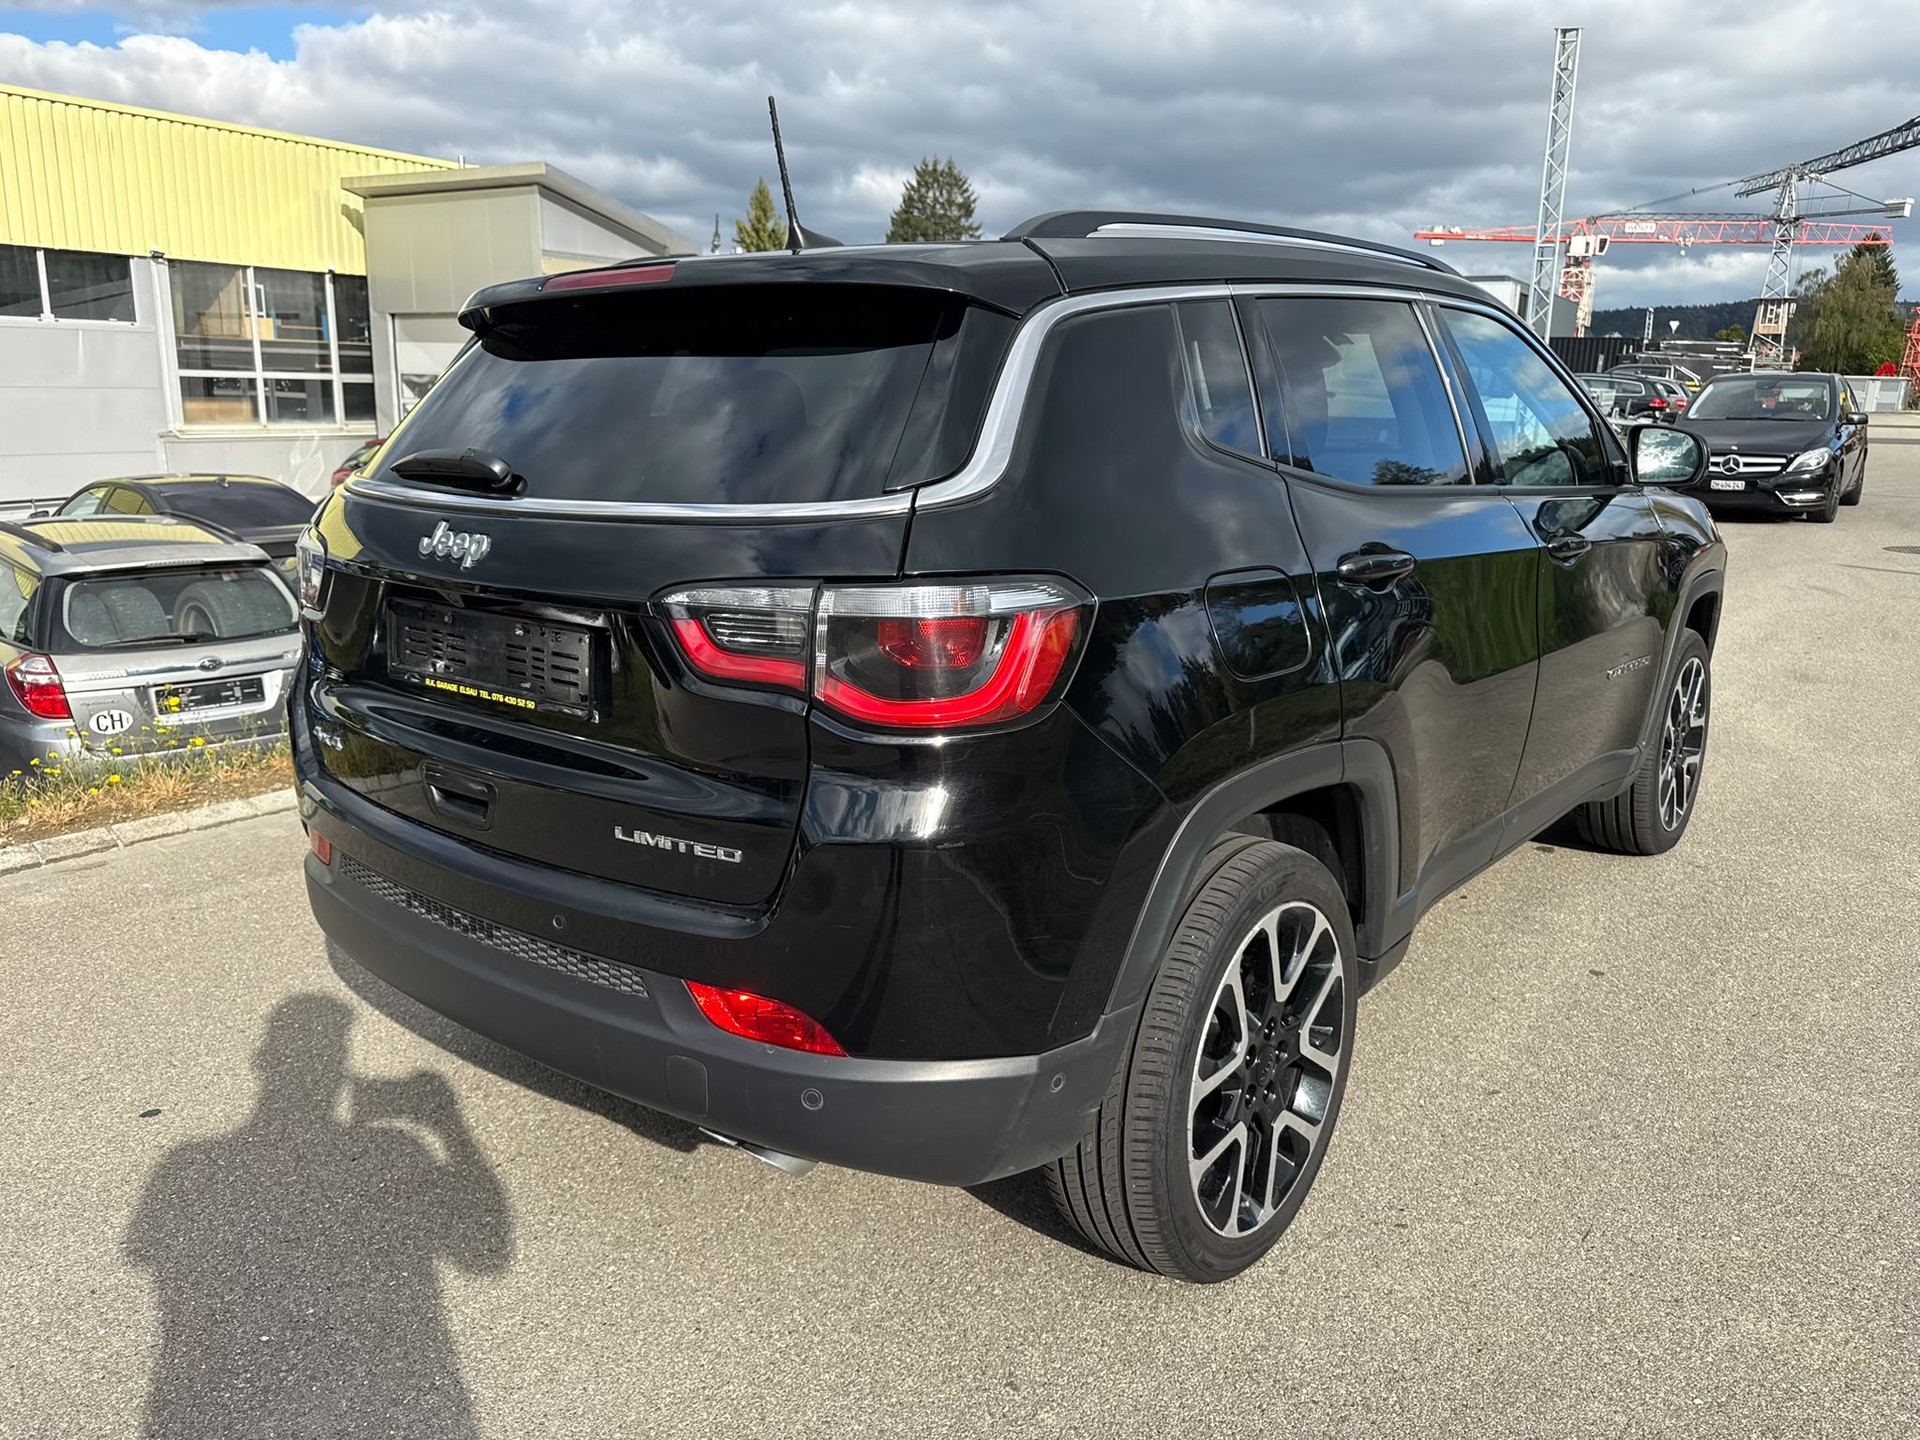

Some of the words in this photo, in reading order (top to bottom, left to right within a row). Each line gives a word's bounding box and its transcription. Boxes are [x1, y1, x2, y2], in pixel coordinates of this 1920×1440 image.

[419, 520, 489, 568] Jeep
[436, 681, 458, 692] GARAGE
[459, 686, 477, 697] ELSAU
[504, 696, 516, 705] 430
[517, 699, 526, 707] 52
[526, 701, 535, 709] 50
[96, 713, 124, 732] CH
[614, 825, 742, 863] LIMITED
